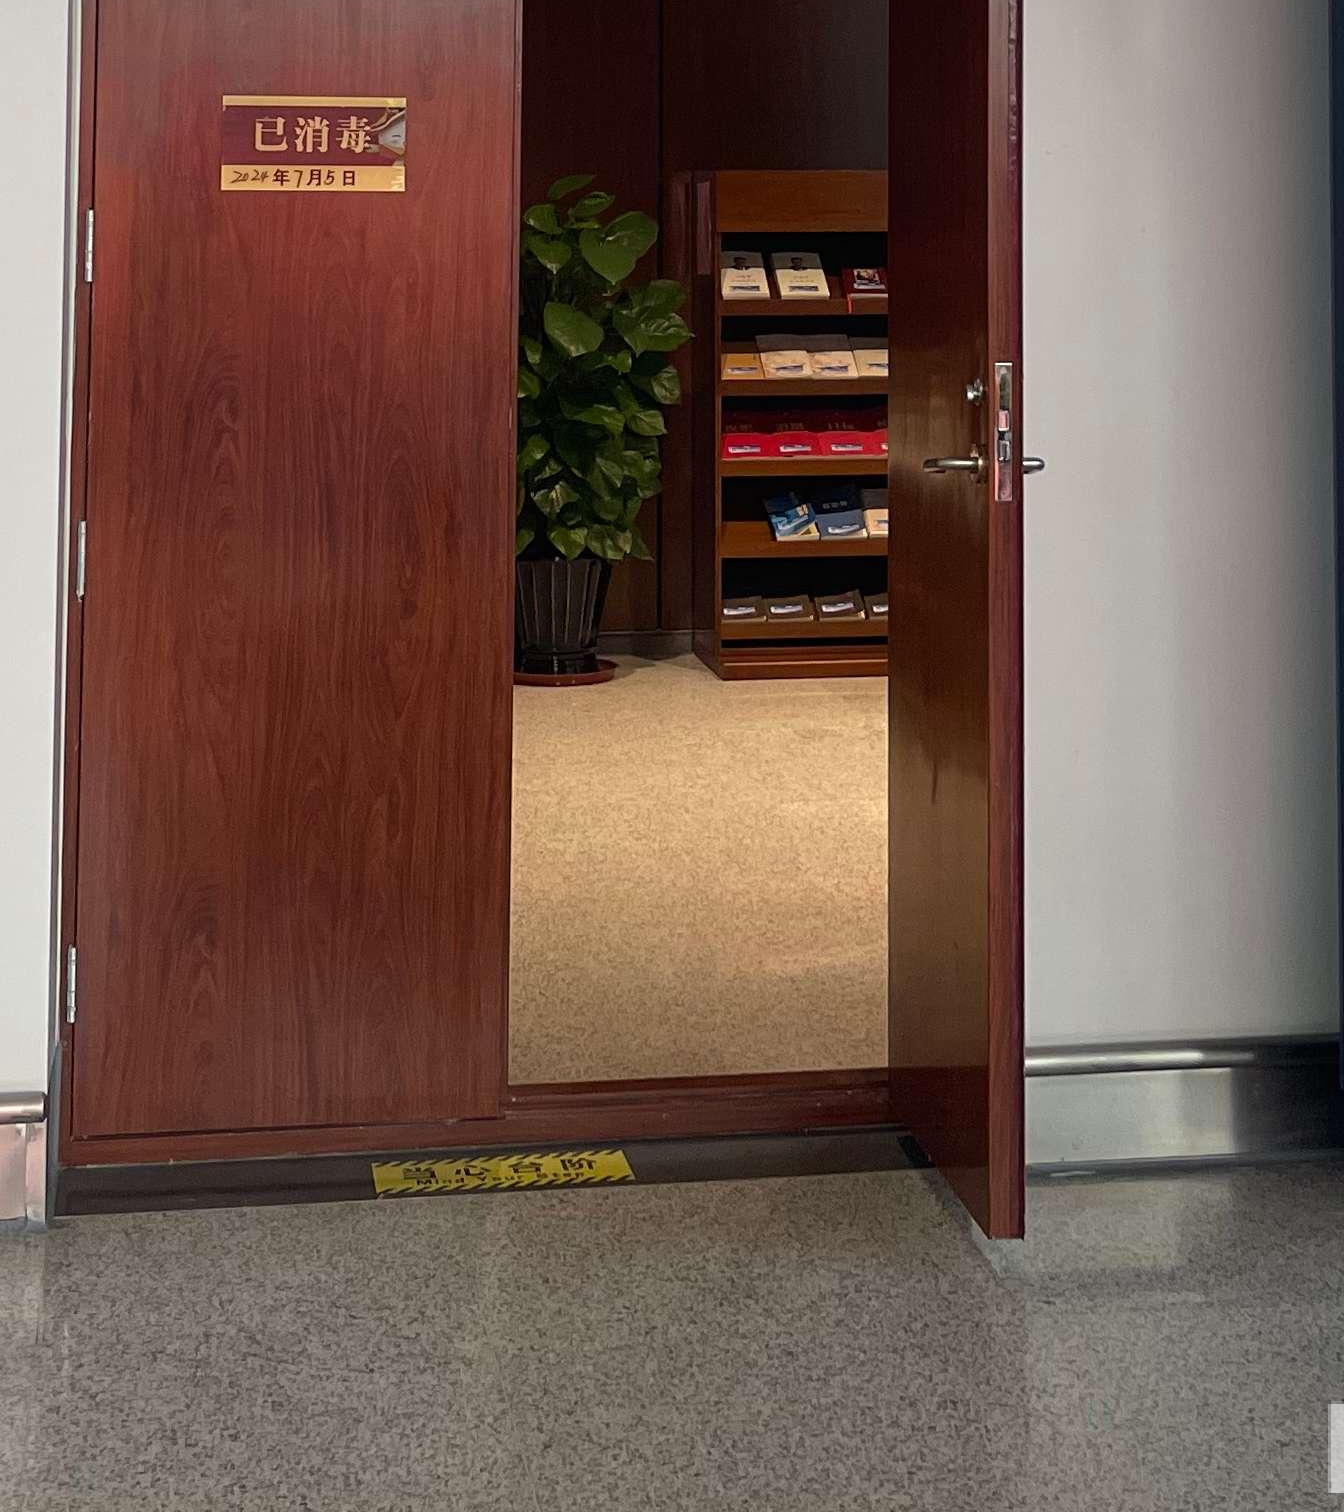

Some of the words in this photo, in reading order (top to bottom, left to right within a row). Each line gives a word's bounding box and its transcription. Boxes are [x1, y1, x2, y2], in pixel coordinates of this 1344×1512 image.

[255, 116, 372, 153] 已消毒
[230, 168, 356, 188] 2024年7月5日
